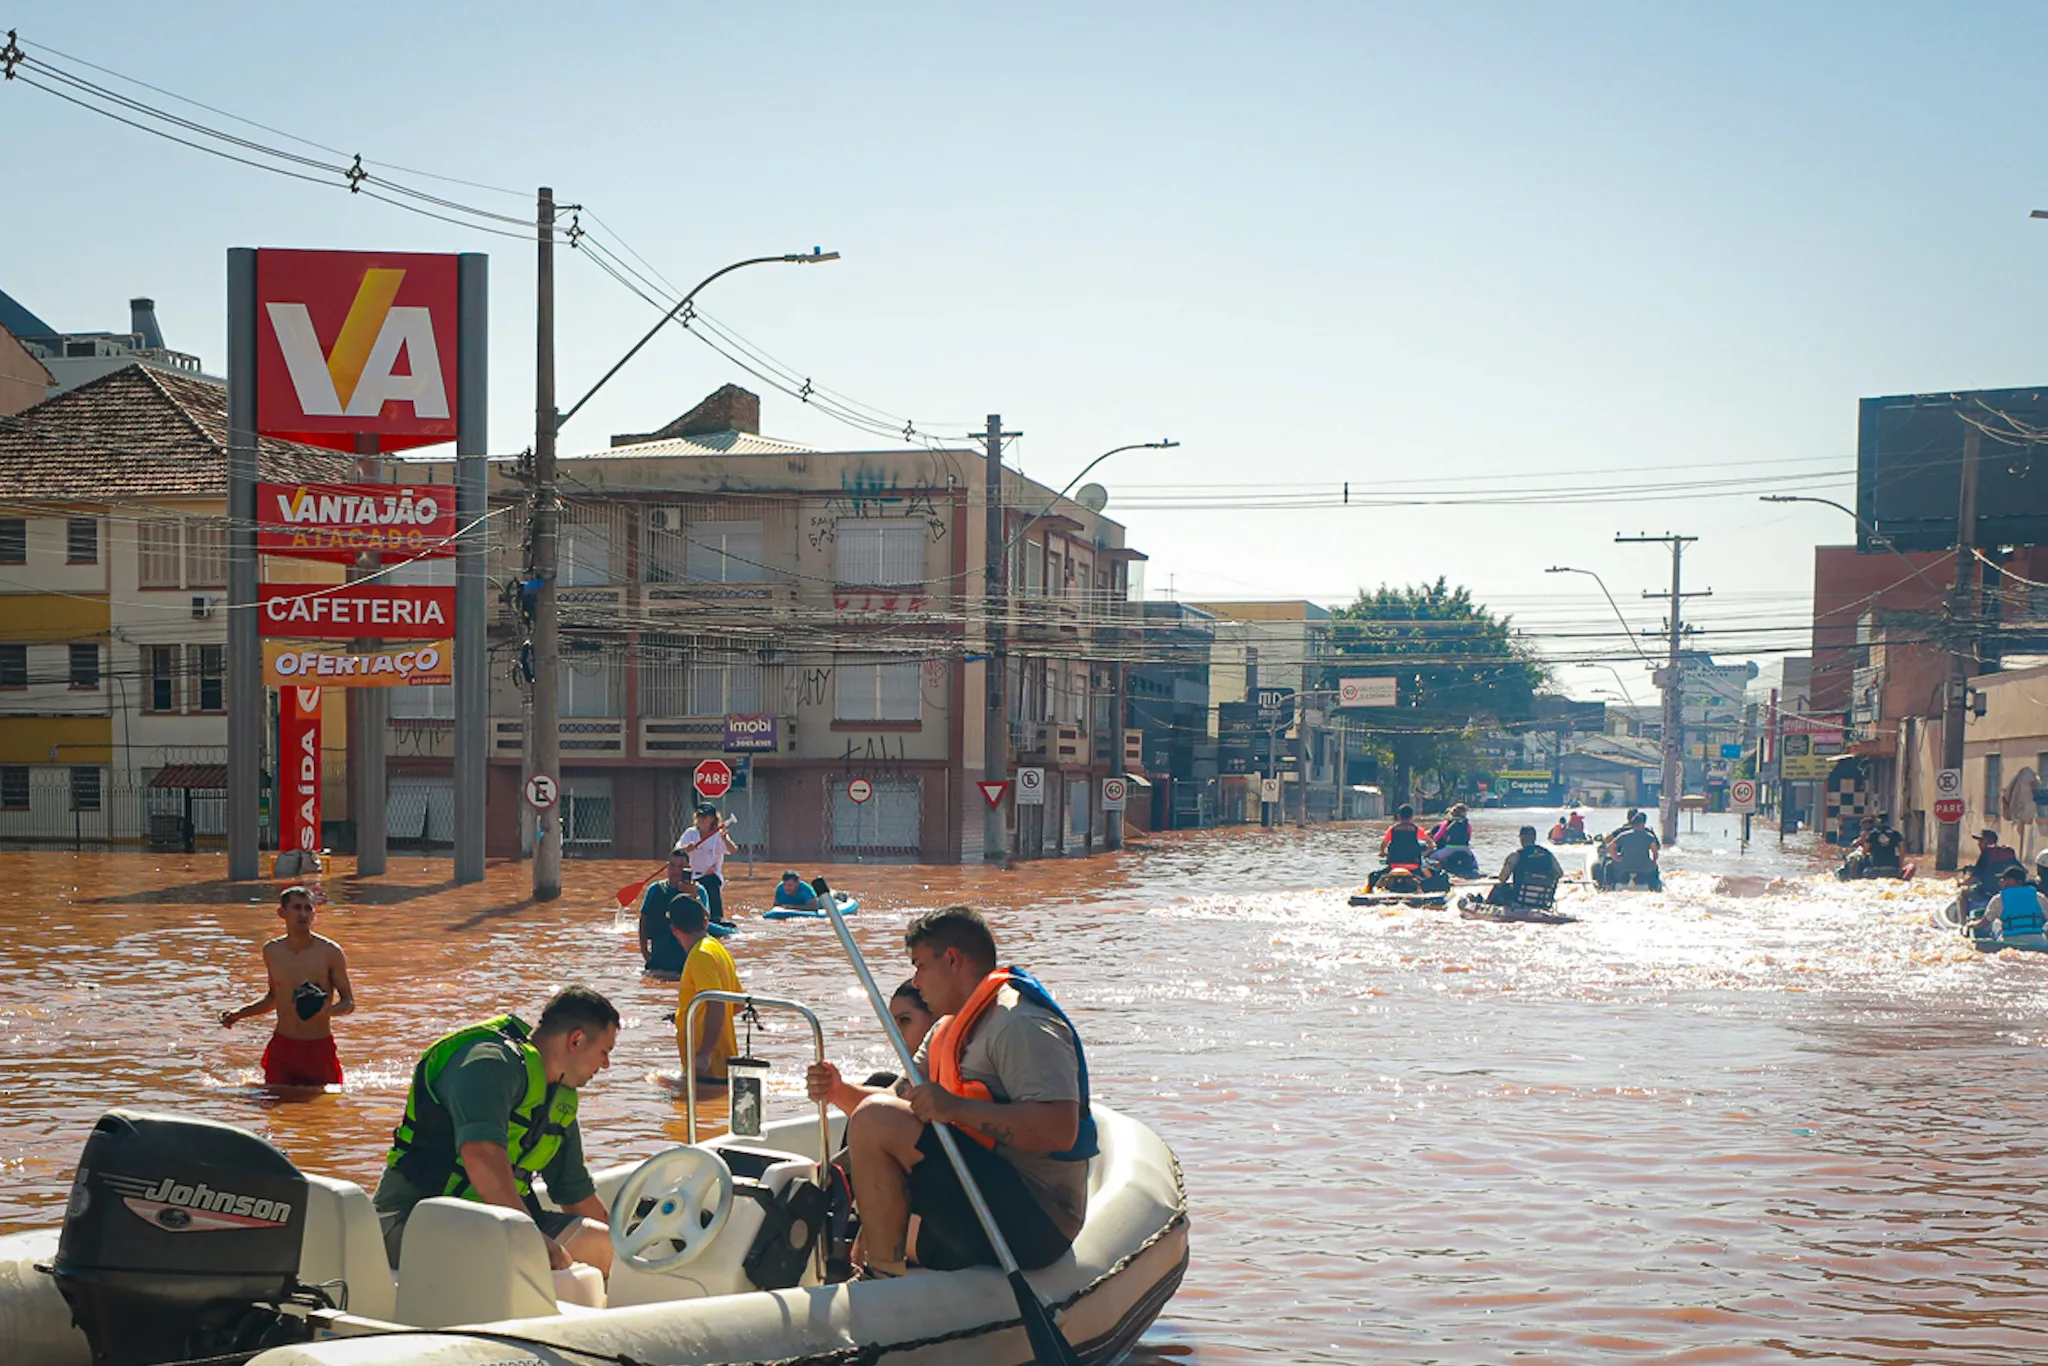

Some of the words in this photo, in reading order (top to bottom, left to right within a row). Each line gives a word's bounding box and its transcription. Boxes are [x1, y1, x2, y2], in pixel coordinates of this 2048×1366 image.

[265, 268, 450, 419] VA
[276, 486, 438, 525] VANTAJÃO
[291, 527, 423, 550] ATACADO
[266, 596, 445, 625] CAFETERIA
[275, 648, 440, 680] OFERTAÇO
[730, 719, 771, 733] imobi
[298, 728, 315, 851] SAÍDA
[697, 772, 729, 785] PARE
[1108, 785, 1121, 795] 60
[535, 781, 548, 801] E
[1736, 787, 1750, 796] 60
[1936, 803, 1963, 813] PARE
[145, 1177, 292, 1223] Johnson
